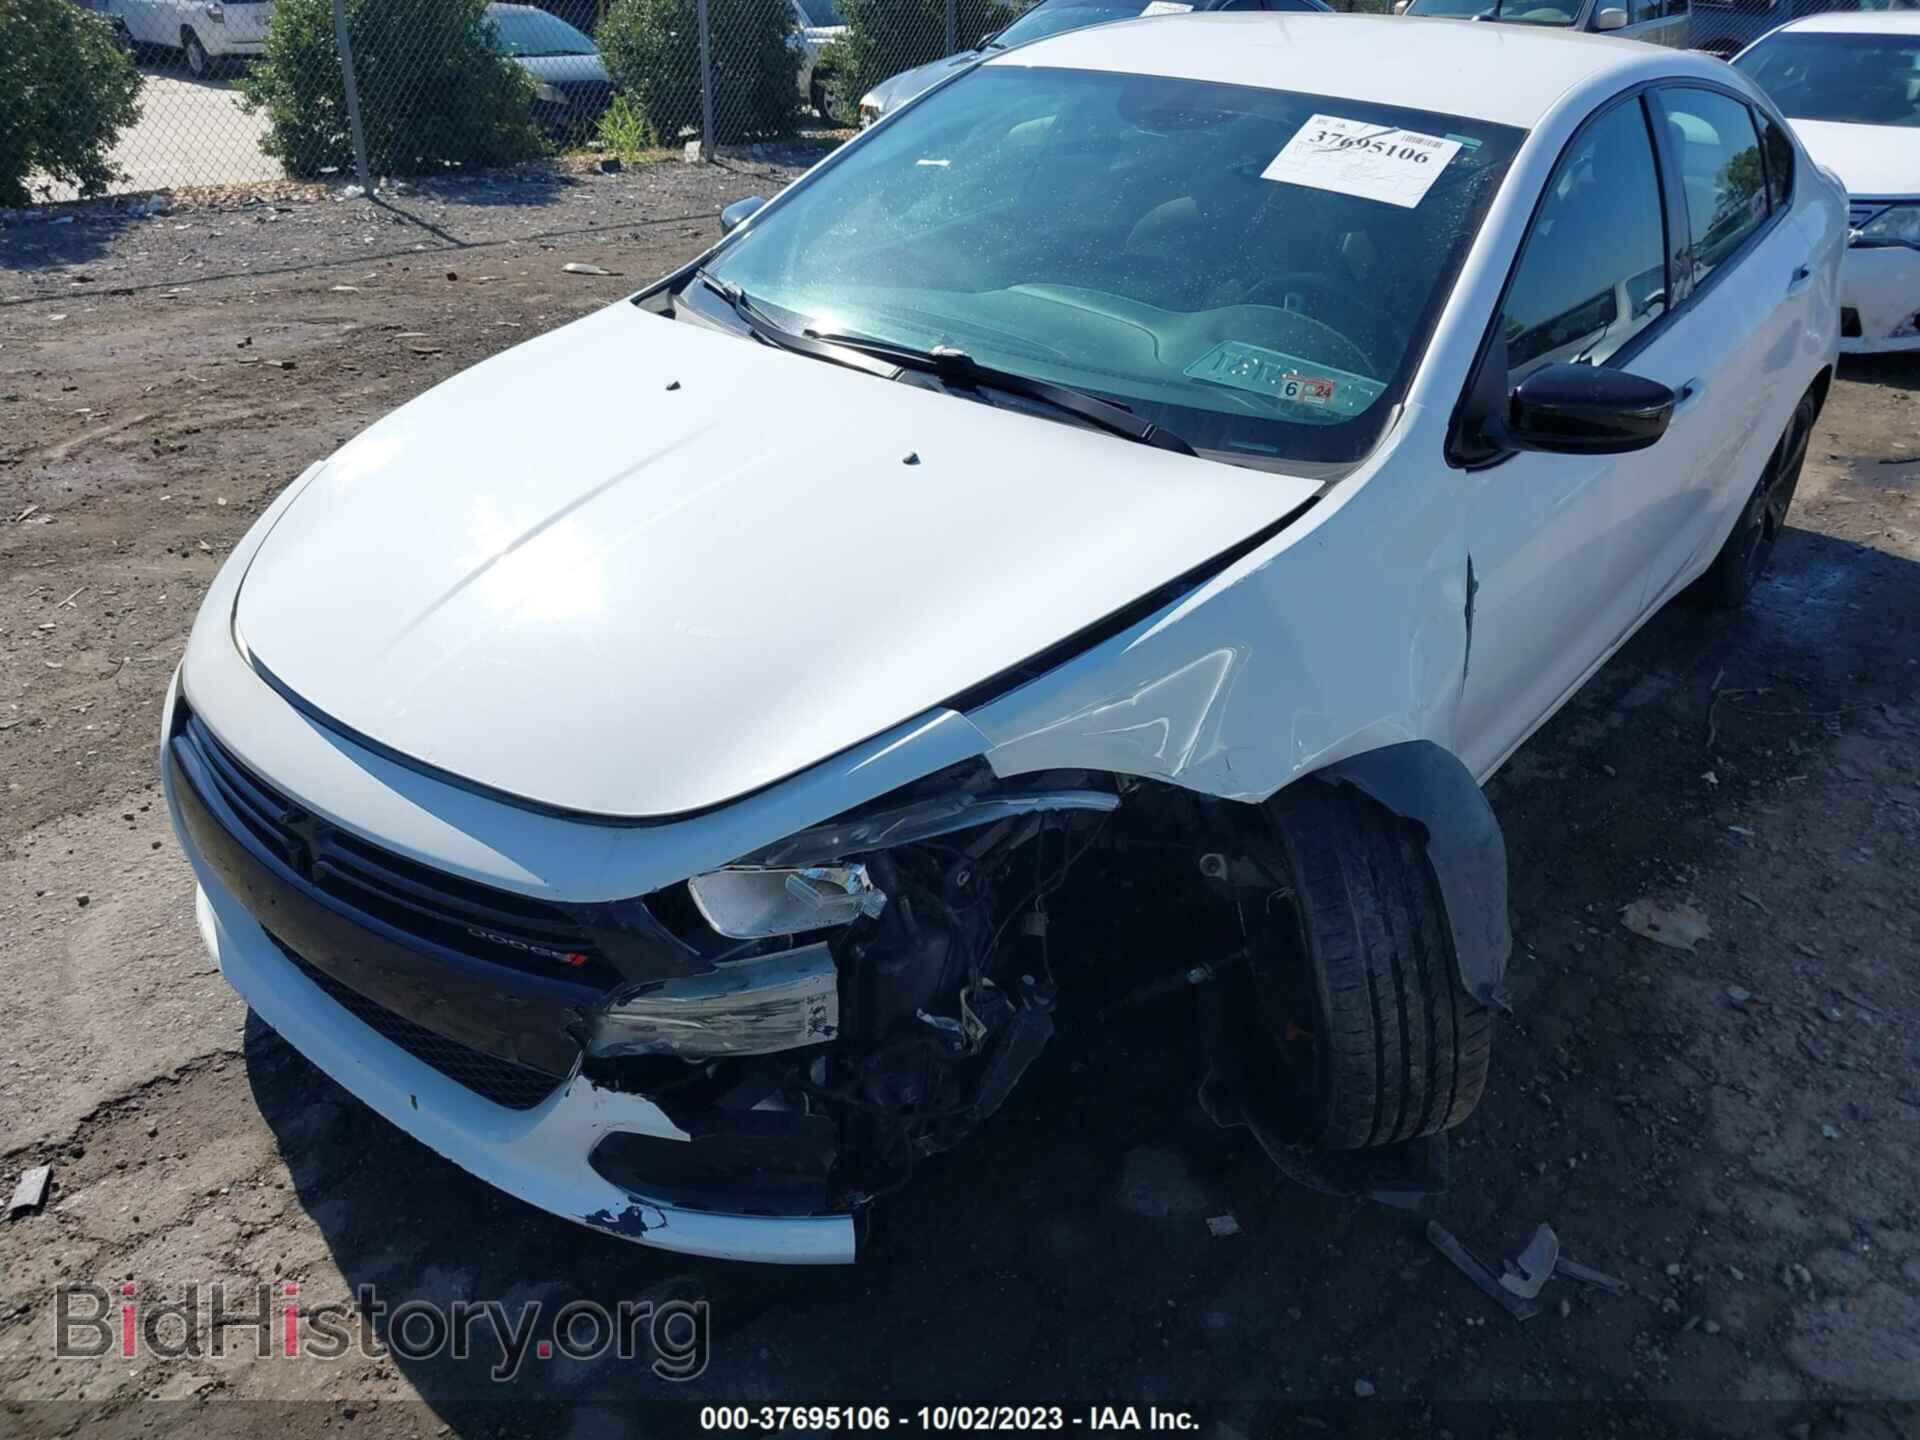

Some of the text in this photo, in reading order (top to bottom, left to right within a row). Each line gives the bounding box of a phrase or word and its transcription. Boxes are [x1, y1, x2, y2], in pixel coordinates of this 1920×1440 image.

[1308, 129, 1430, 165] 37695106
[1285, 381, 1332, 398] 6 24
